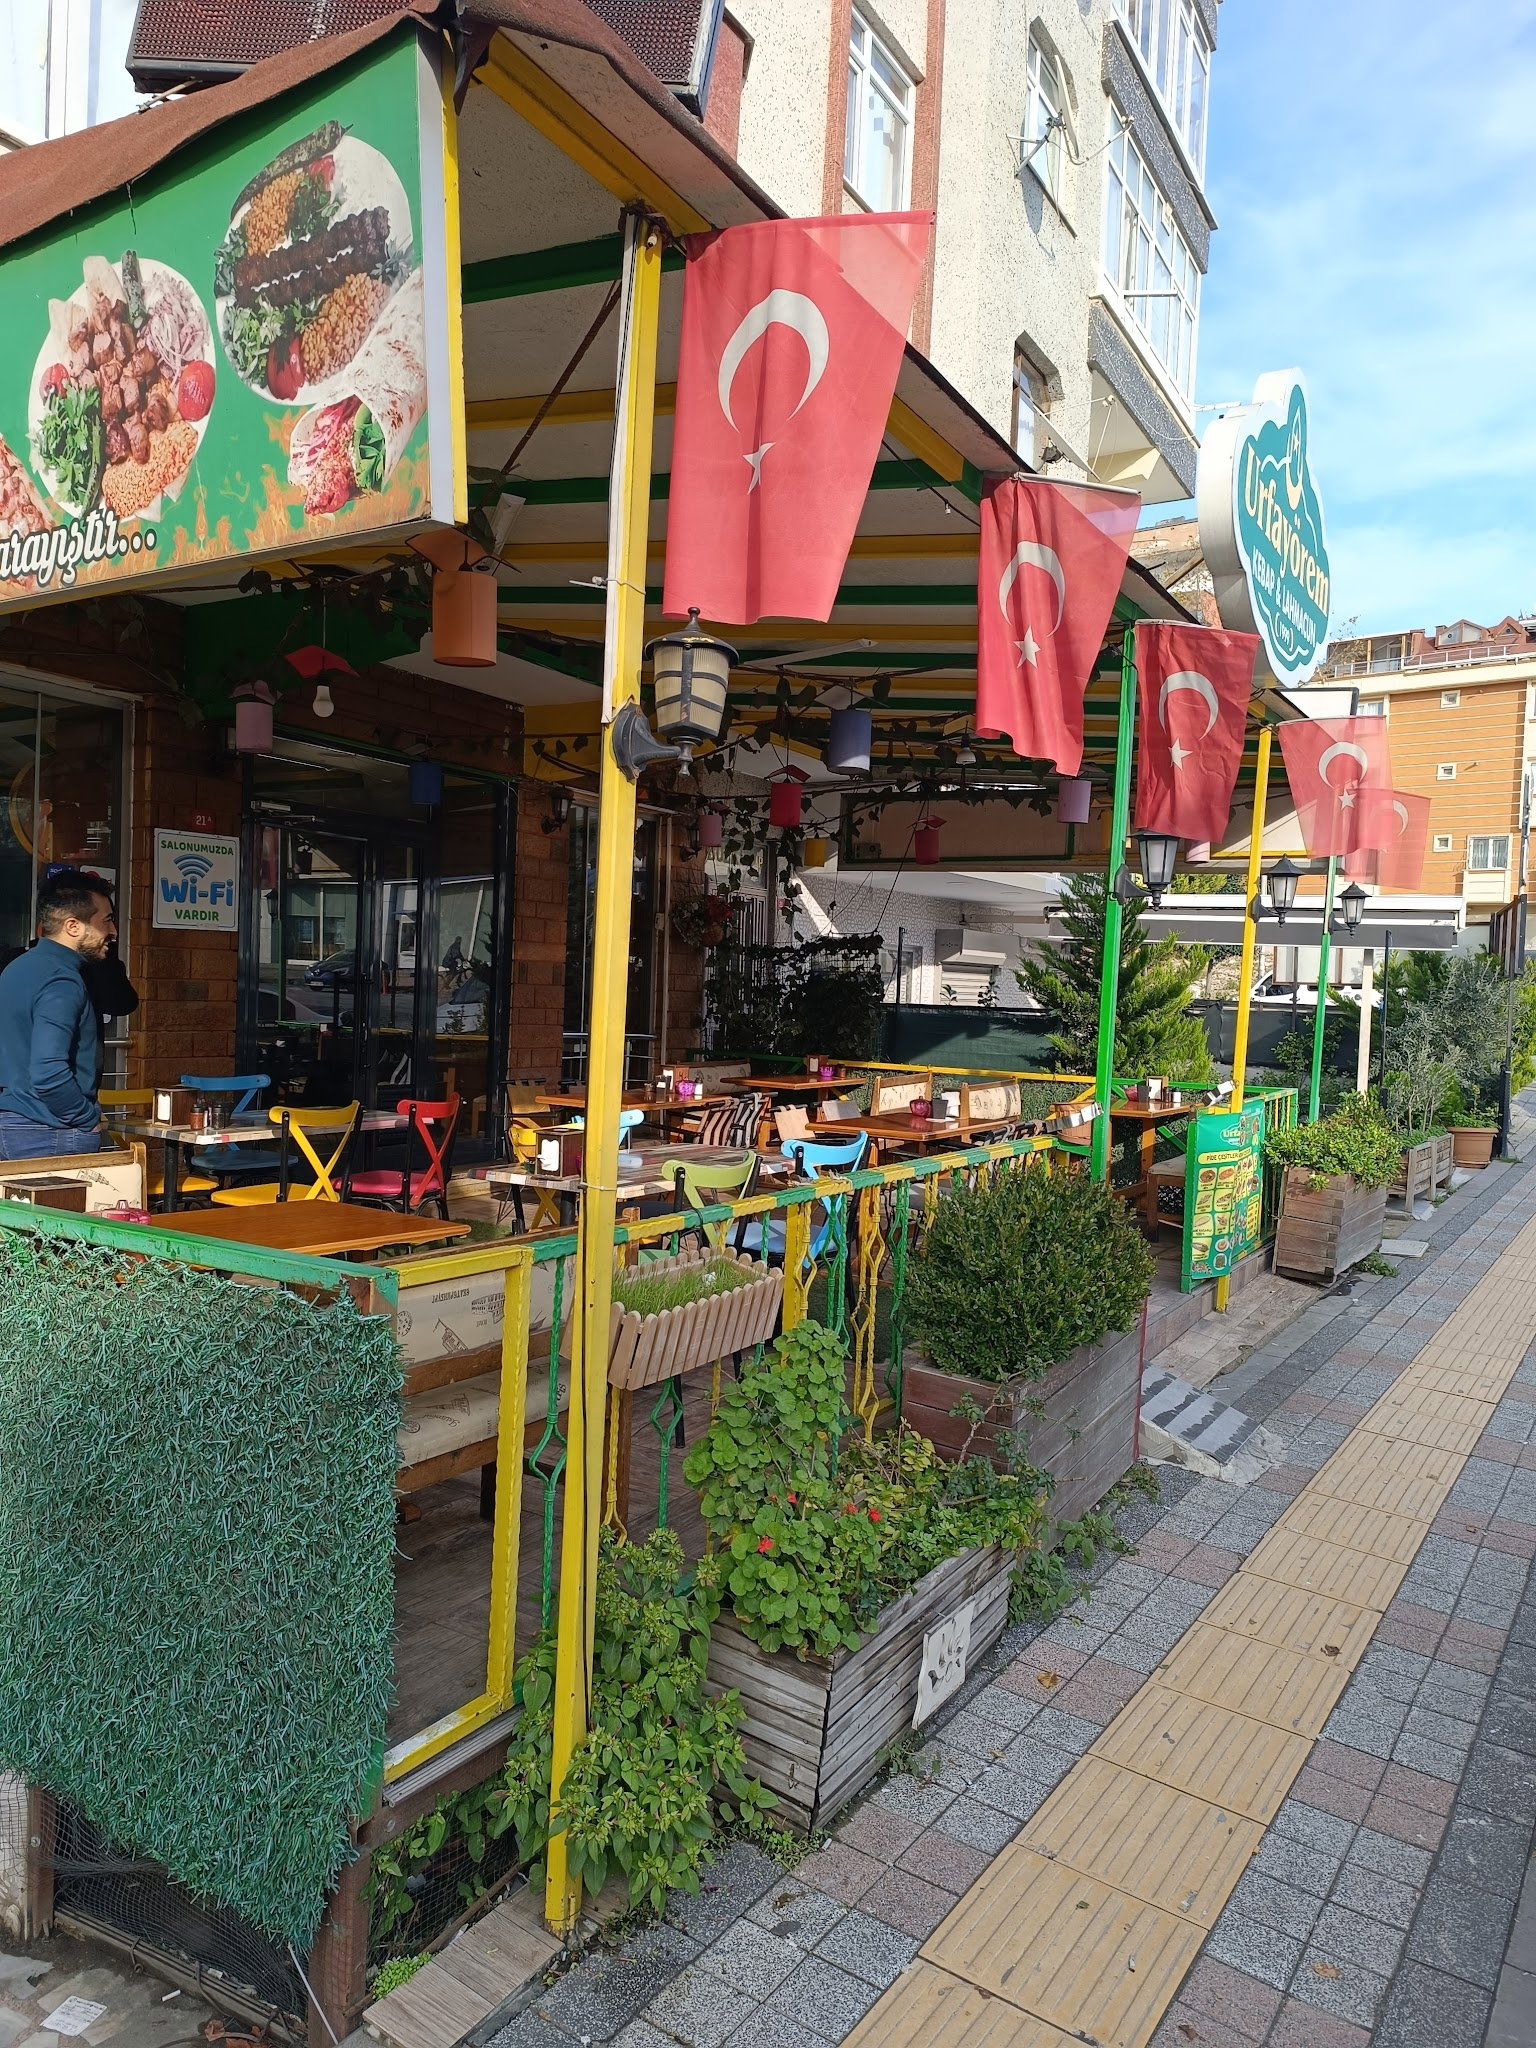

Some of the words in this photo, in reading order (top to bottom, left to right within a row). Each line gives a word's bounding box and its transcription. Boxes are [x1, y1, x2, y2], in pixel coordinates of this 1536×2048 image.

[1244, 441, 1329, 618] Urfayörem
[1252, 545, 1275, 597] KEBAP
[1275, 577, 1282, 607] &
[1282, 584, 1317, 648] LAHMACUN
[160, 840, 234, 855] SALONUMUZDA
[160, 876, 234, 907] Wi-Fi
[174, 909, 220, 921] VARDIR
